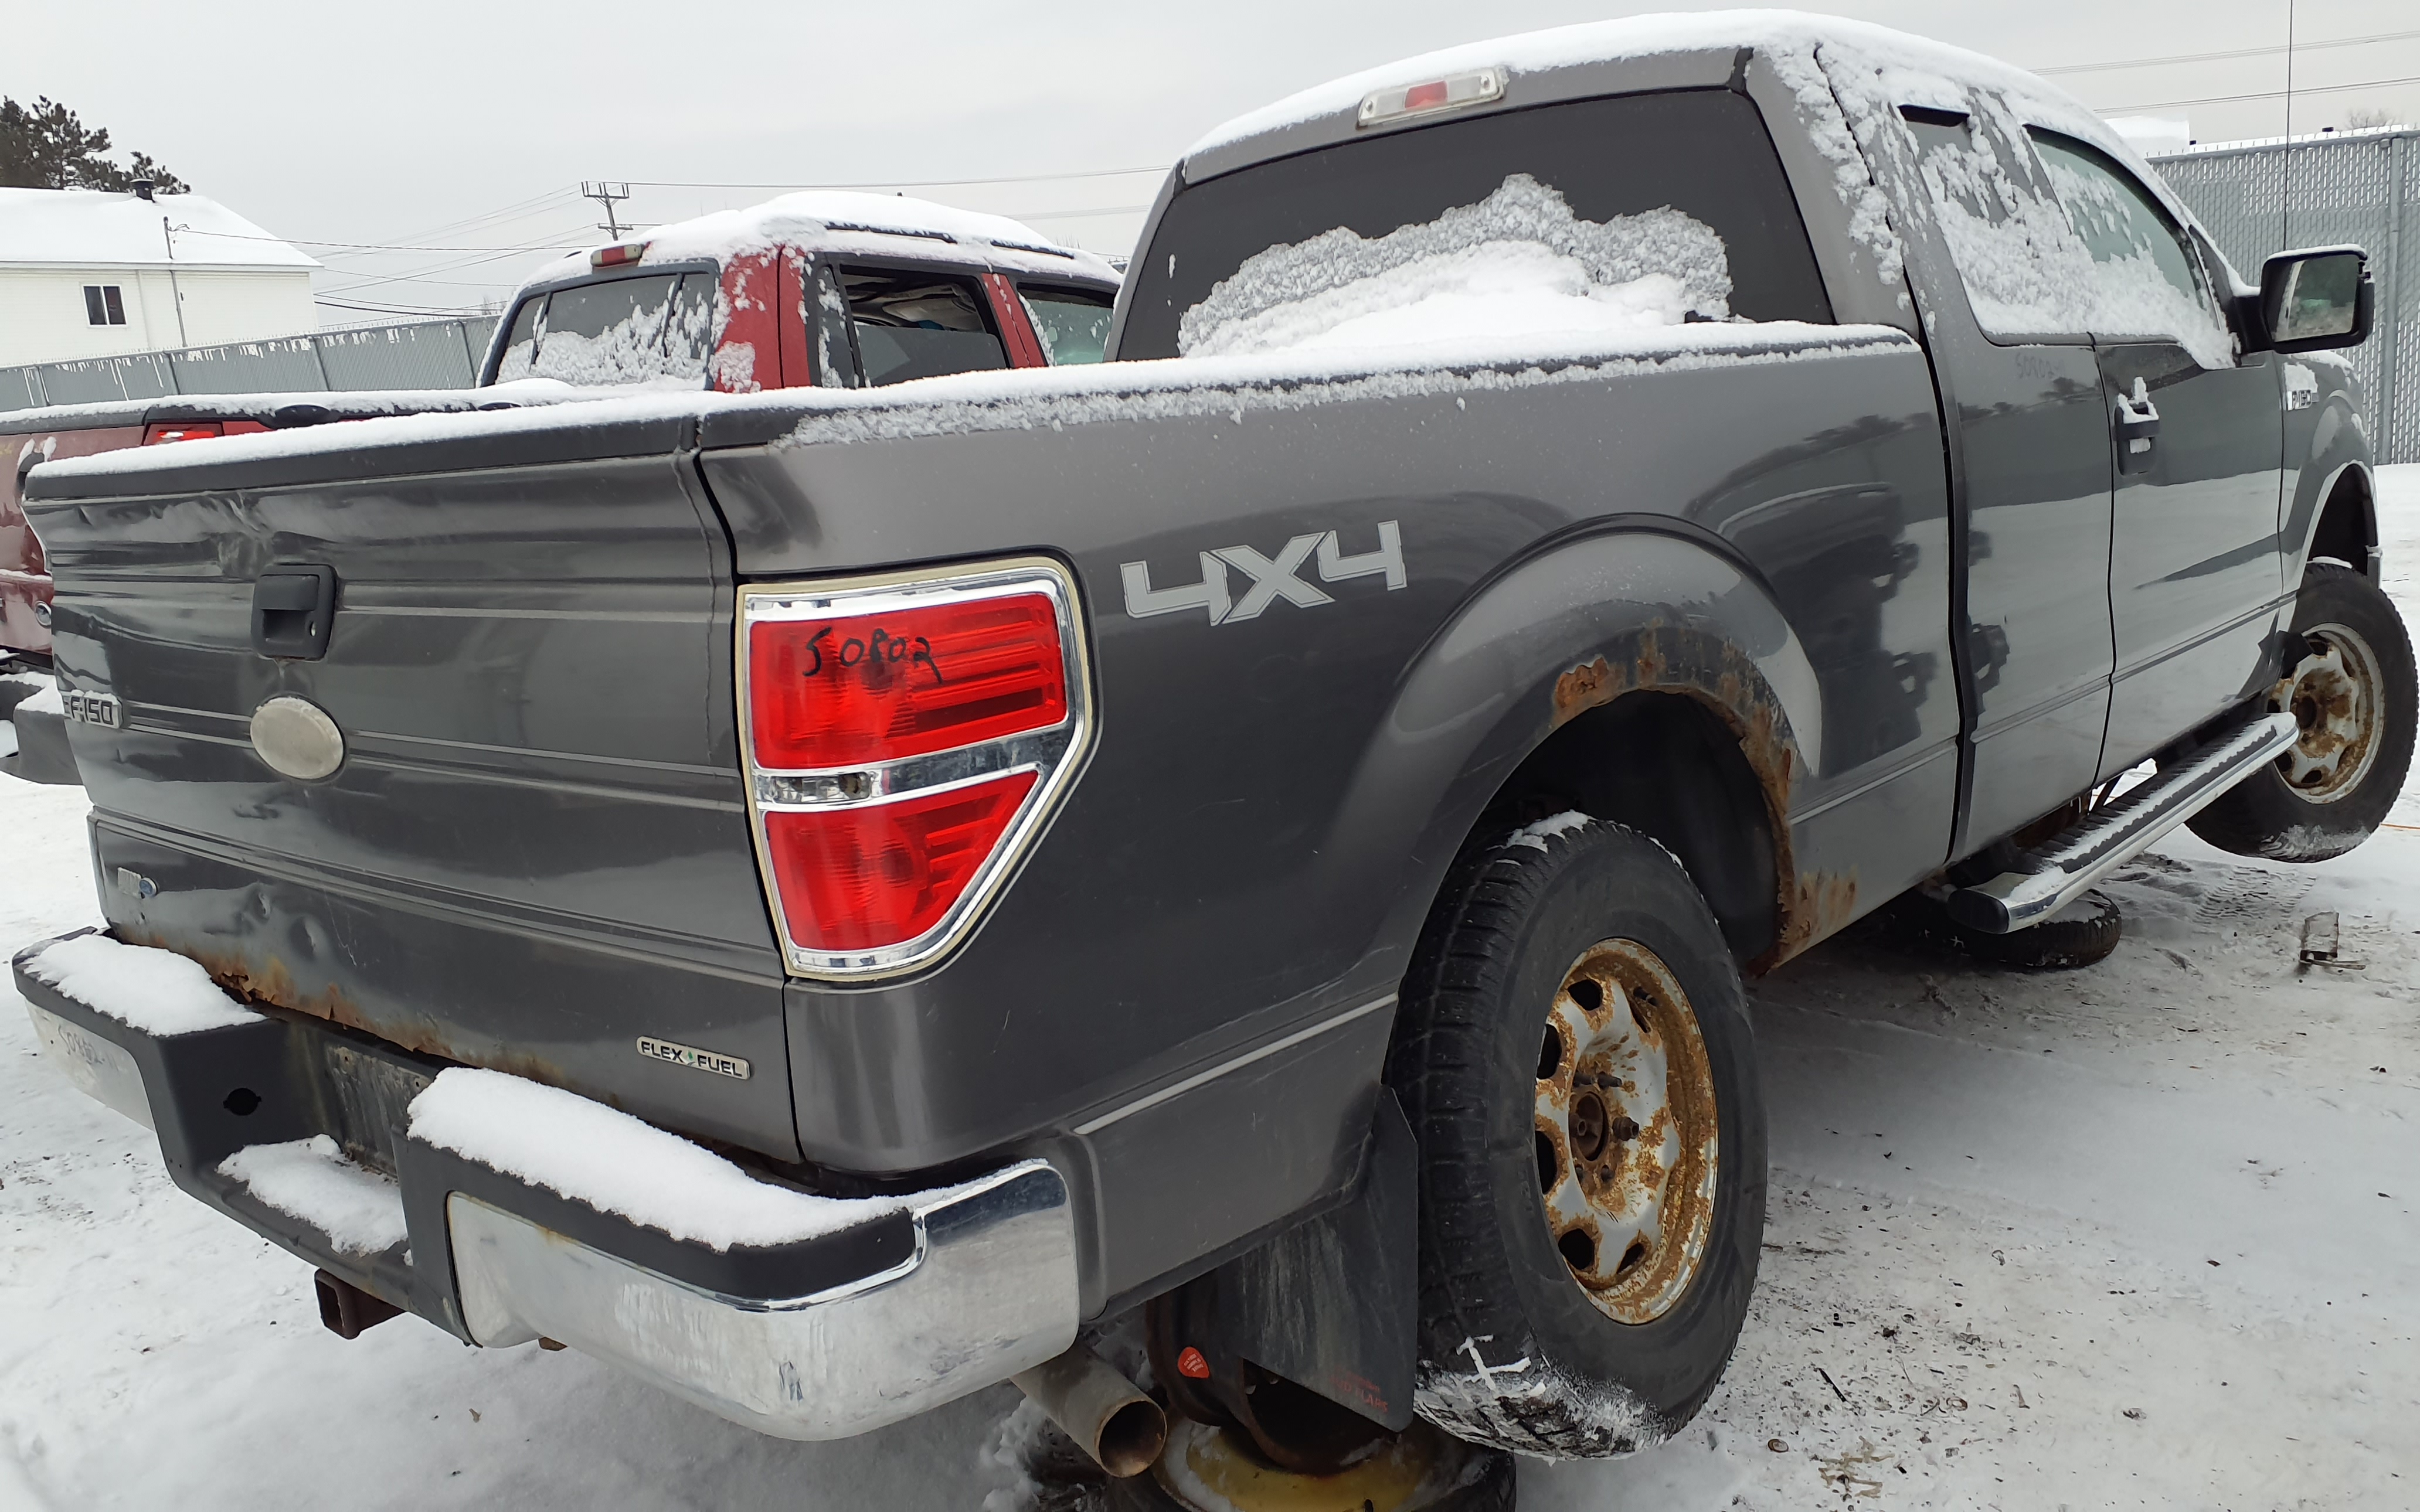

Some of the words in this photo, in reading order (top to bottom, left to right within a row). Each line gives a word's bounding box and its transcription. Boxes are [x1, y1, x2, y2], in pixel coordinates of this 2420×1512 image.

[70, 696, 114, 726] F-150
[641, 1041, 684, 1063] FLEX
[697, 1054, 743, 1077] FUEL
